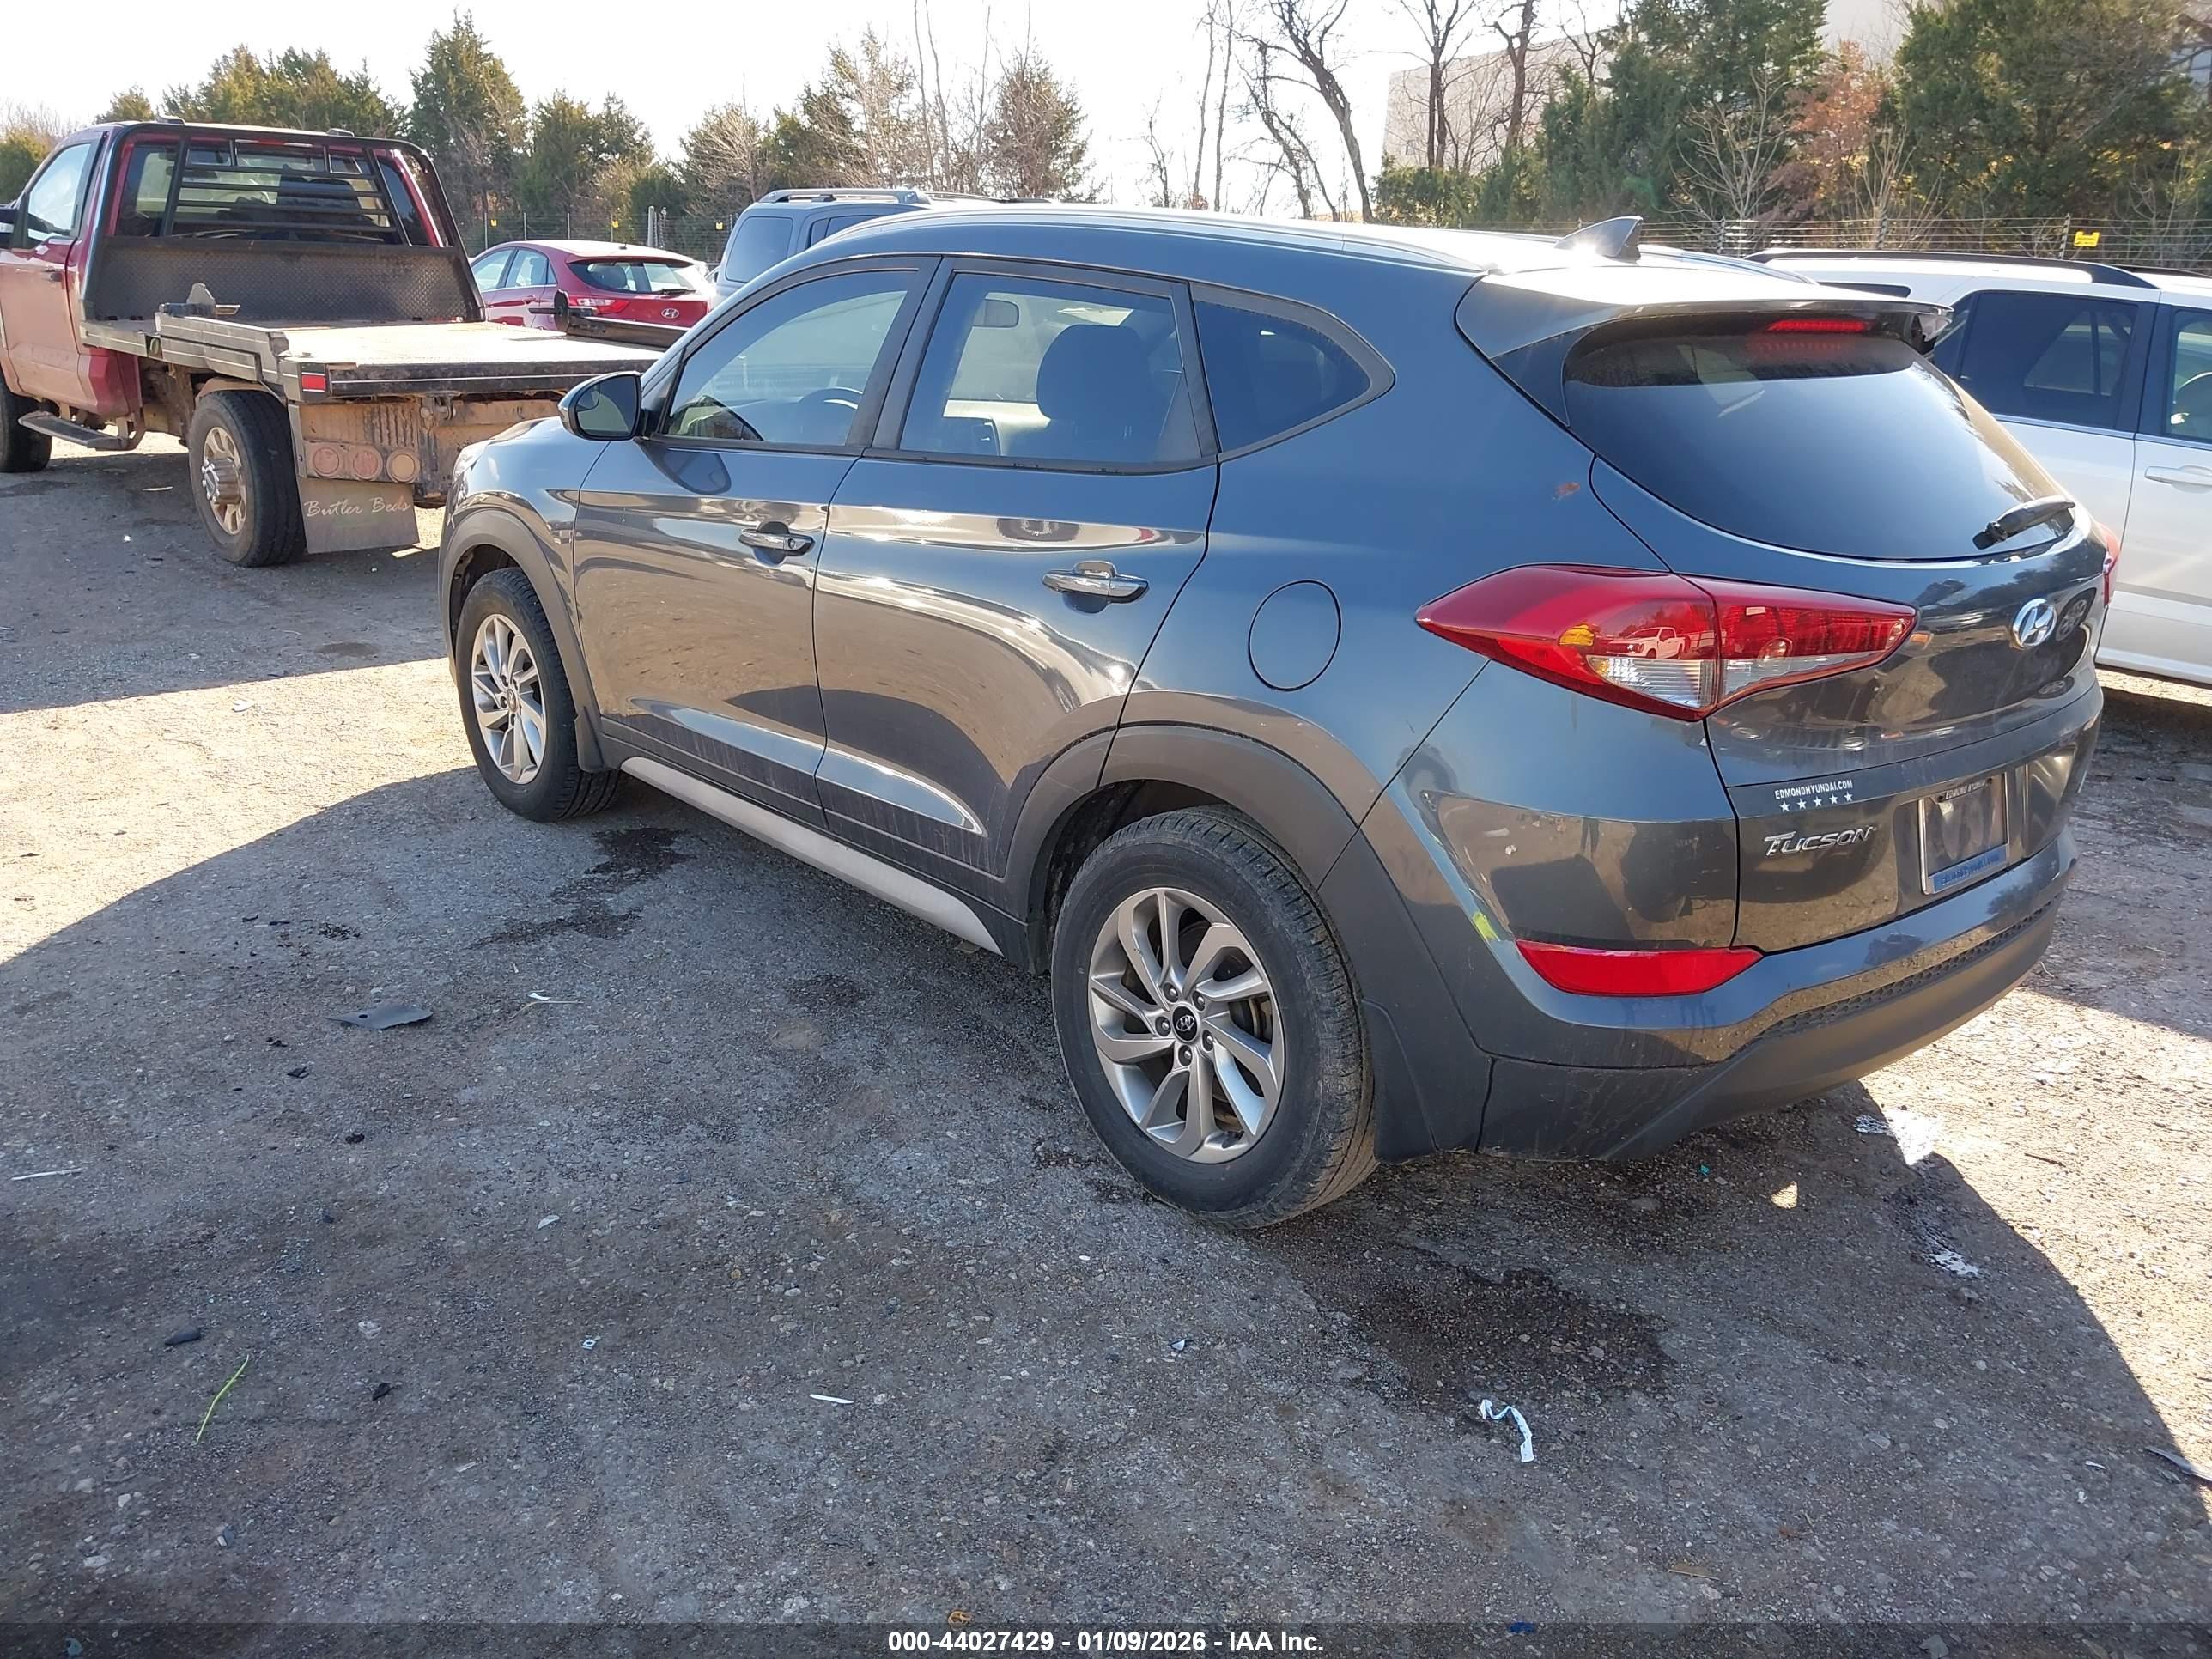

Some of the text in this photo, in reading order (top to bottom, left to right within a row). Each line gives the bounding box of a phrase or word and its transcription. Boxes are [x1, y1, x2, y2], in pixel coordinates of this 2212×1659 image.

[303, 496, 411, 517] Butler Beds
[1774, 779, 1854, 799] EDMONDHYUNDAI.COM
[1764, 825, 1875, 856] TUCSON
